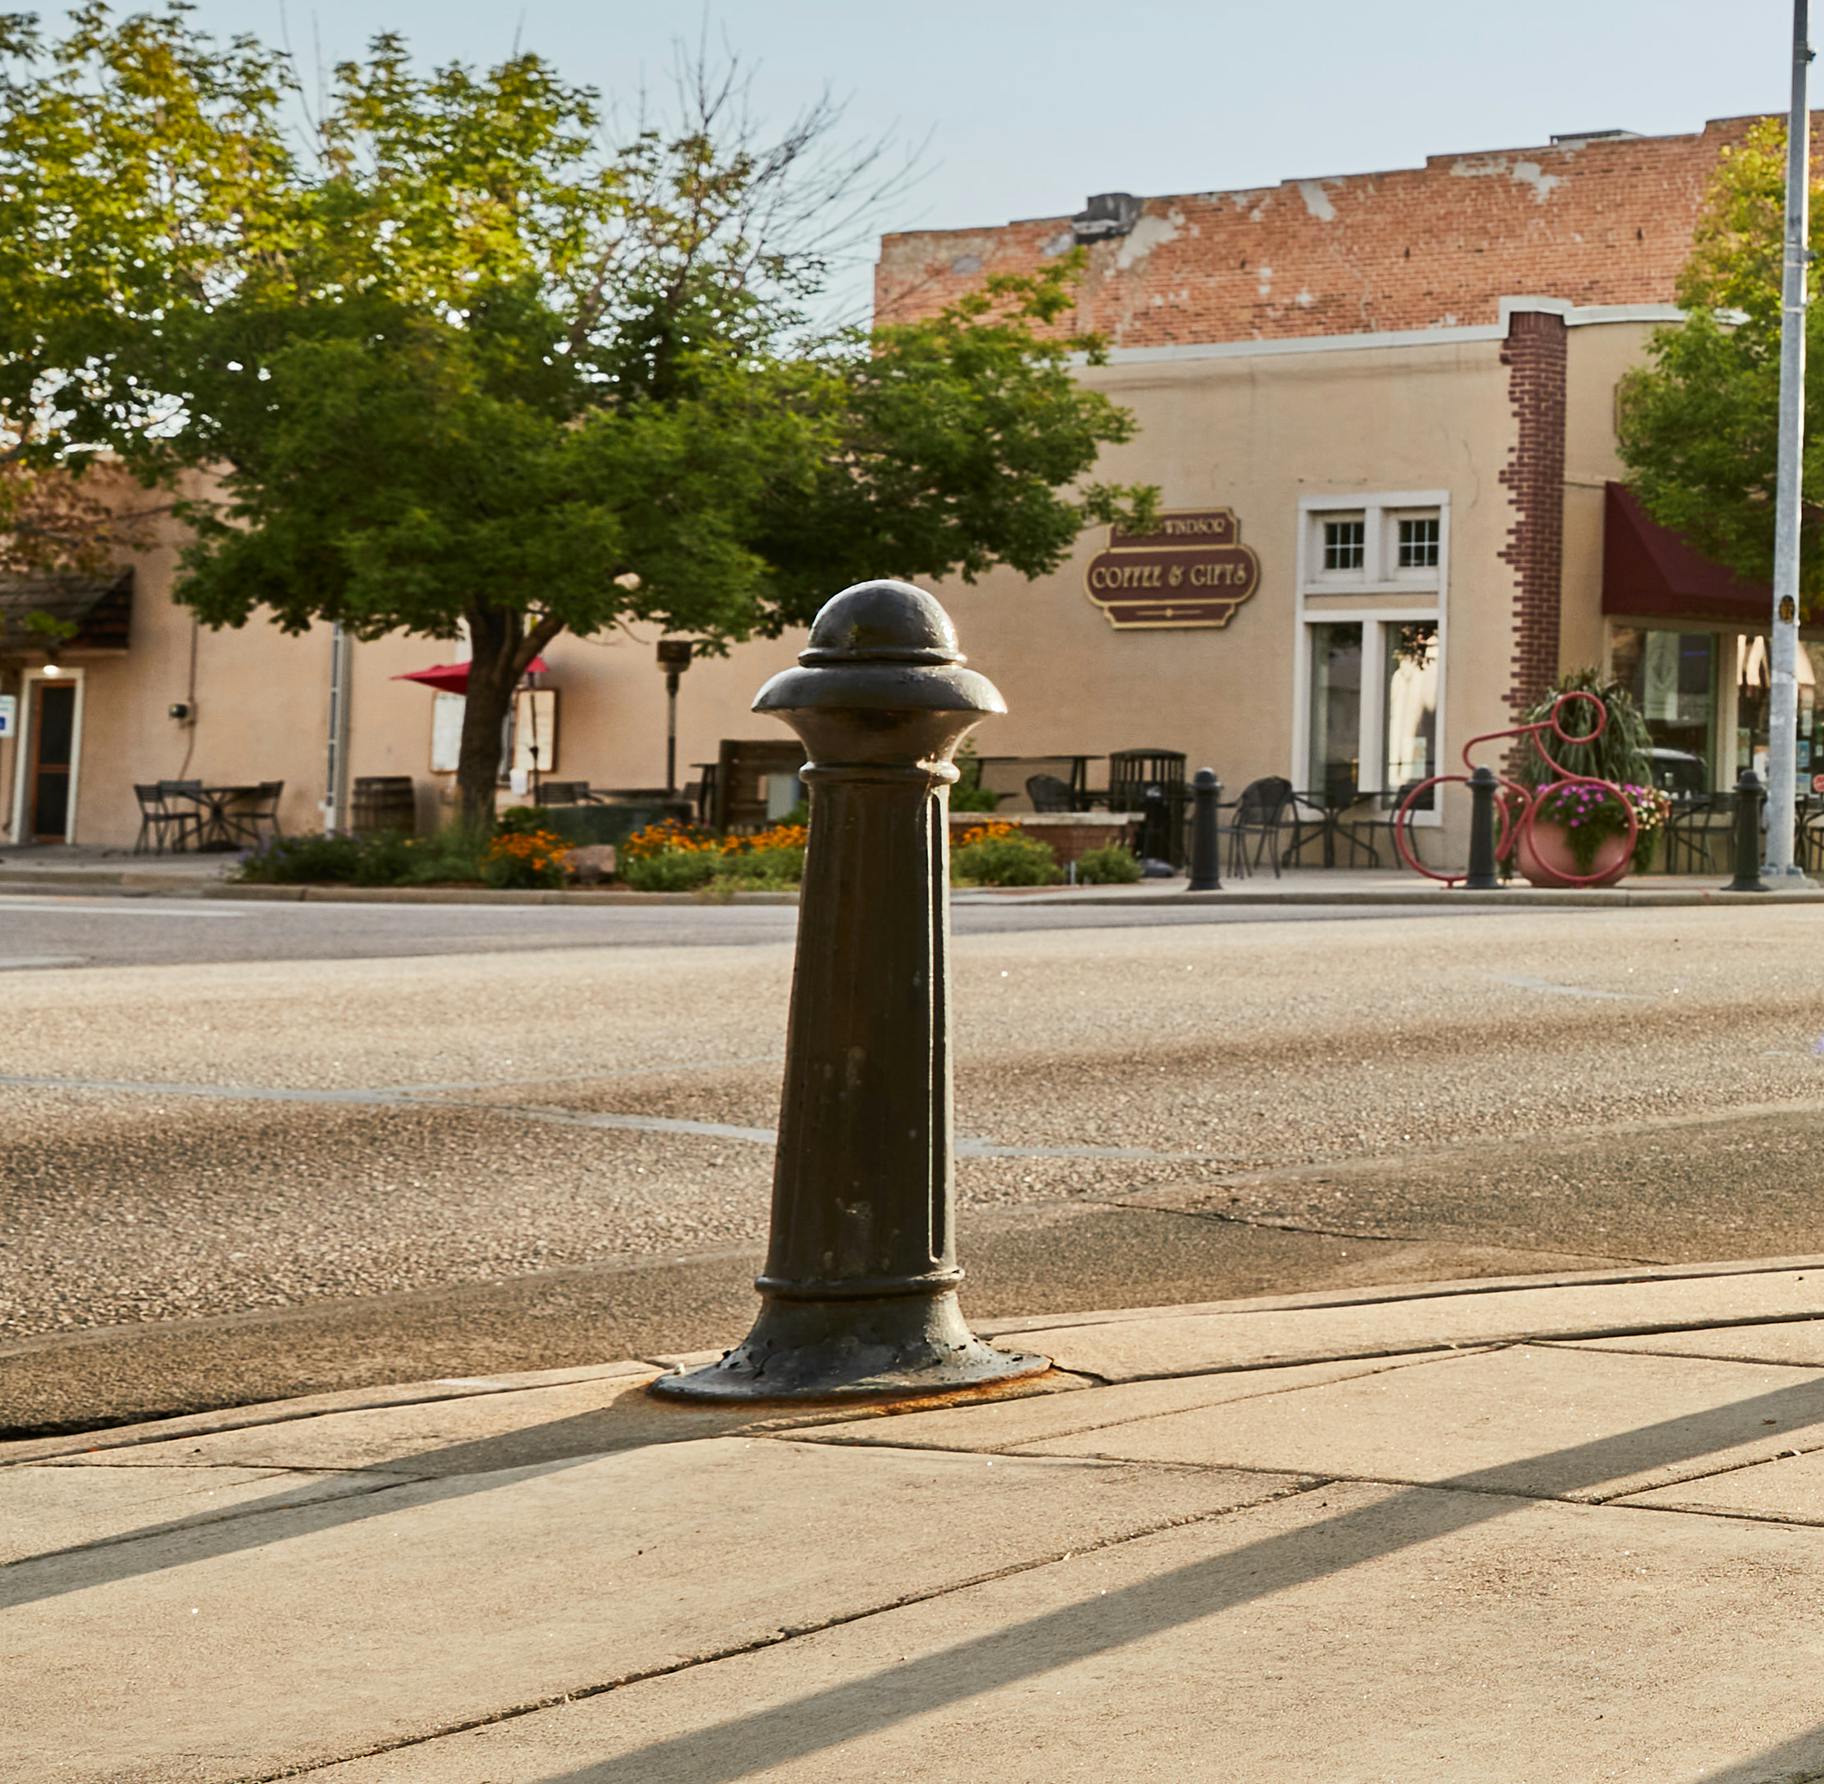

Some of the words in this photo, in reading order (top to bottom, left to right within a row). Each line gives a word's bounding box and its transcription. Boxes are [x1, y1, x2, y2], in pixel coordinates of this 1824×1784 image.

[1165, 519, 1225, 535] WINDSOR
[1092, 565, 1162, 588] COFFEE
[1168, 564, 1184, 586] &
[1190, 563, 1246, 586] GIFTS
